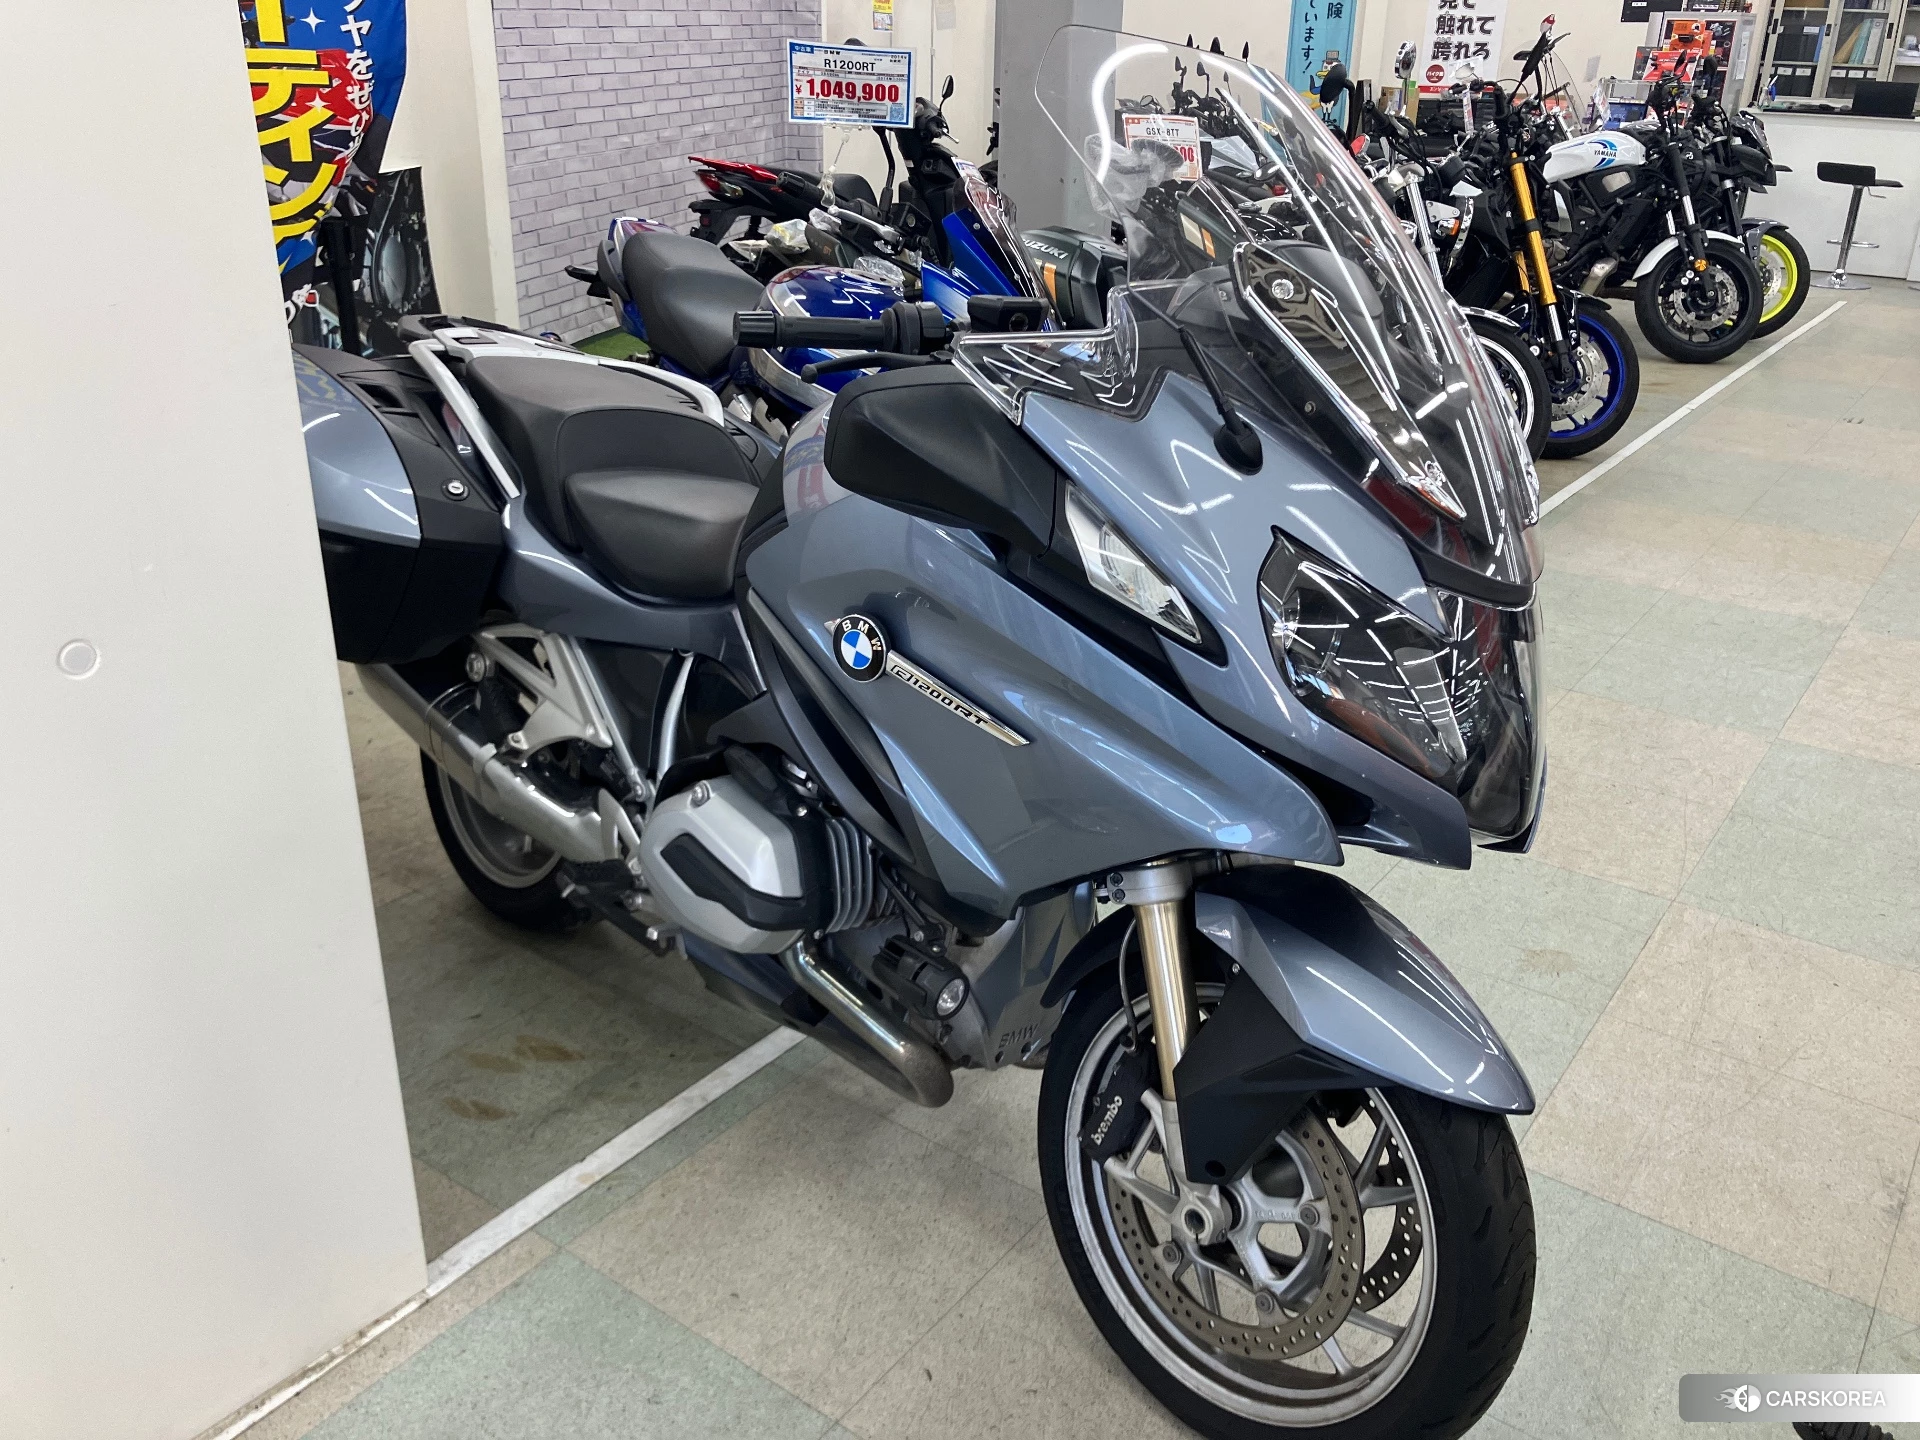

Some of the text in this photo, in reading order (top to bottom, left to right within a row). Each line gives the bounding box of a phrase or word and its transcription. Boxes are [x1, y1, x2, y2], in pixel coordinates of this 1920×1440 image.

[1436, 14, 1495, 35] 触れて
[824, 58, 876, 72] R1200RT
[806, 78, 900, 103] 1,049,900
[1594, 149, 1617, 158] YAMAHA
[842, 619, 882, 651] BMW
[890, 664, 989, 727] R1200RT
[998, 1023, 1038, 1049] BMW
[1091, 1095, 1123, 1146] brembo
